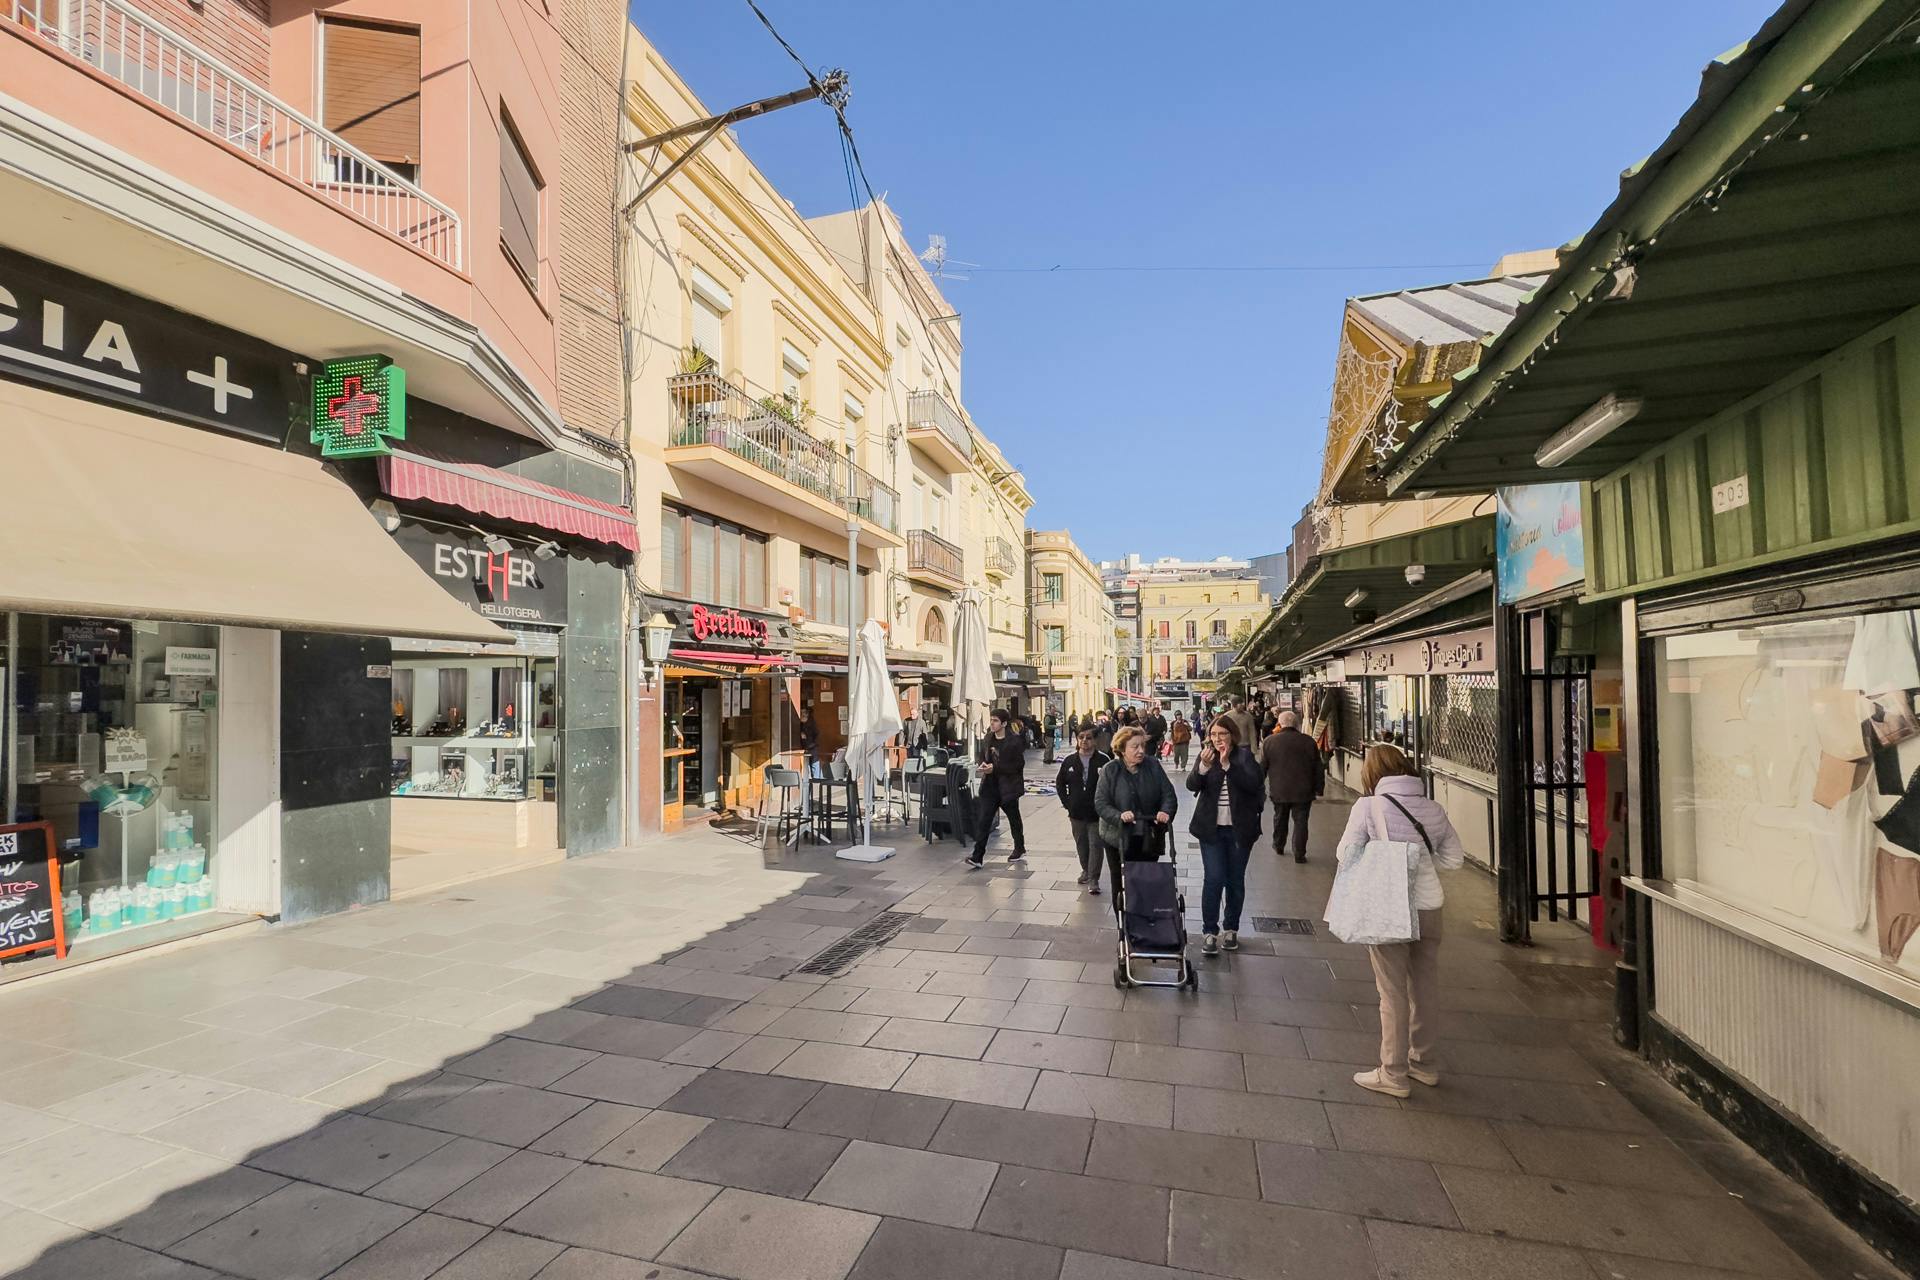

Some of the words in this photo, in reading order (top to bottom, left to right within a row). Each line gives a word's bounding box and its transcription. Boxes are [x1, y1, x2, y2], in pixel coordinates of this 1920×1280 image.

[1717, 483, 1743, 506] 203
[435, 543, 538, 601] ESTHER
[481, 604, 541, 619] RELLOTGERIA
[692, 604, 769, 647] Freiburg
